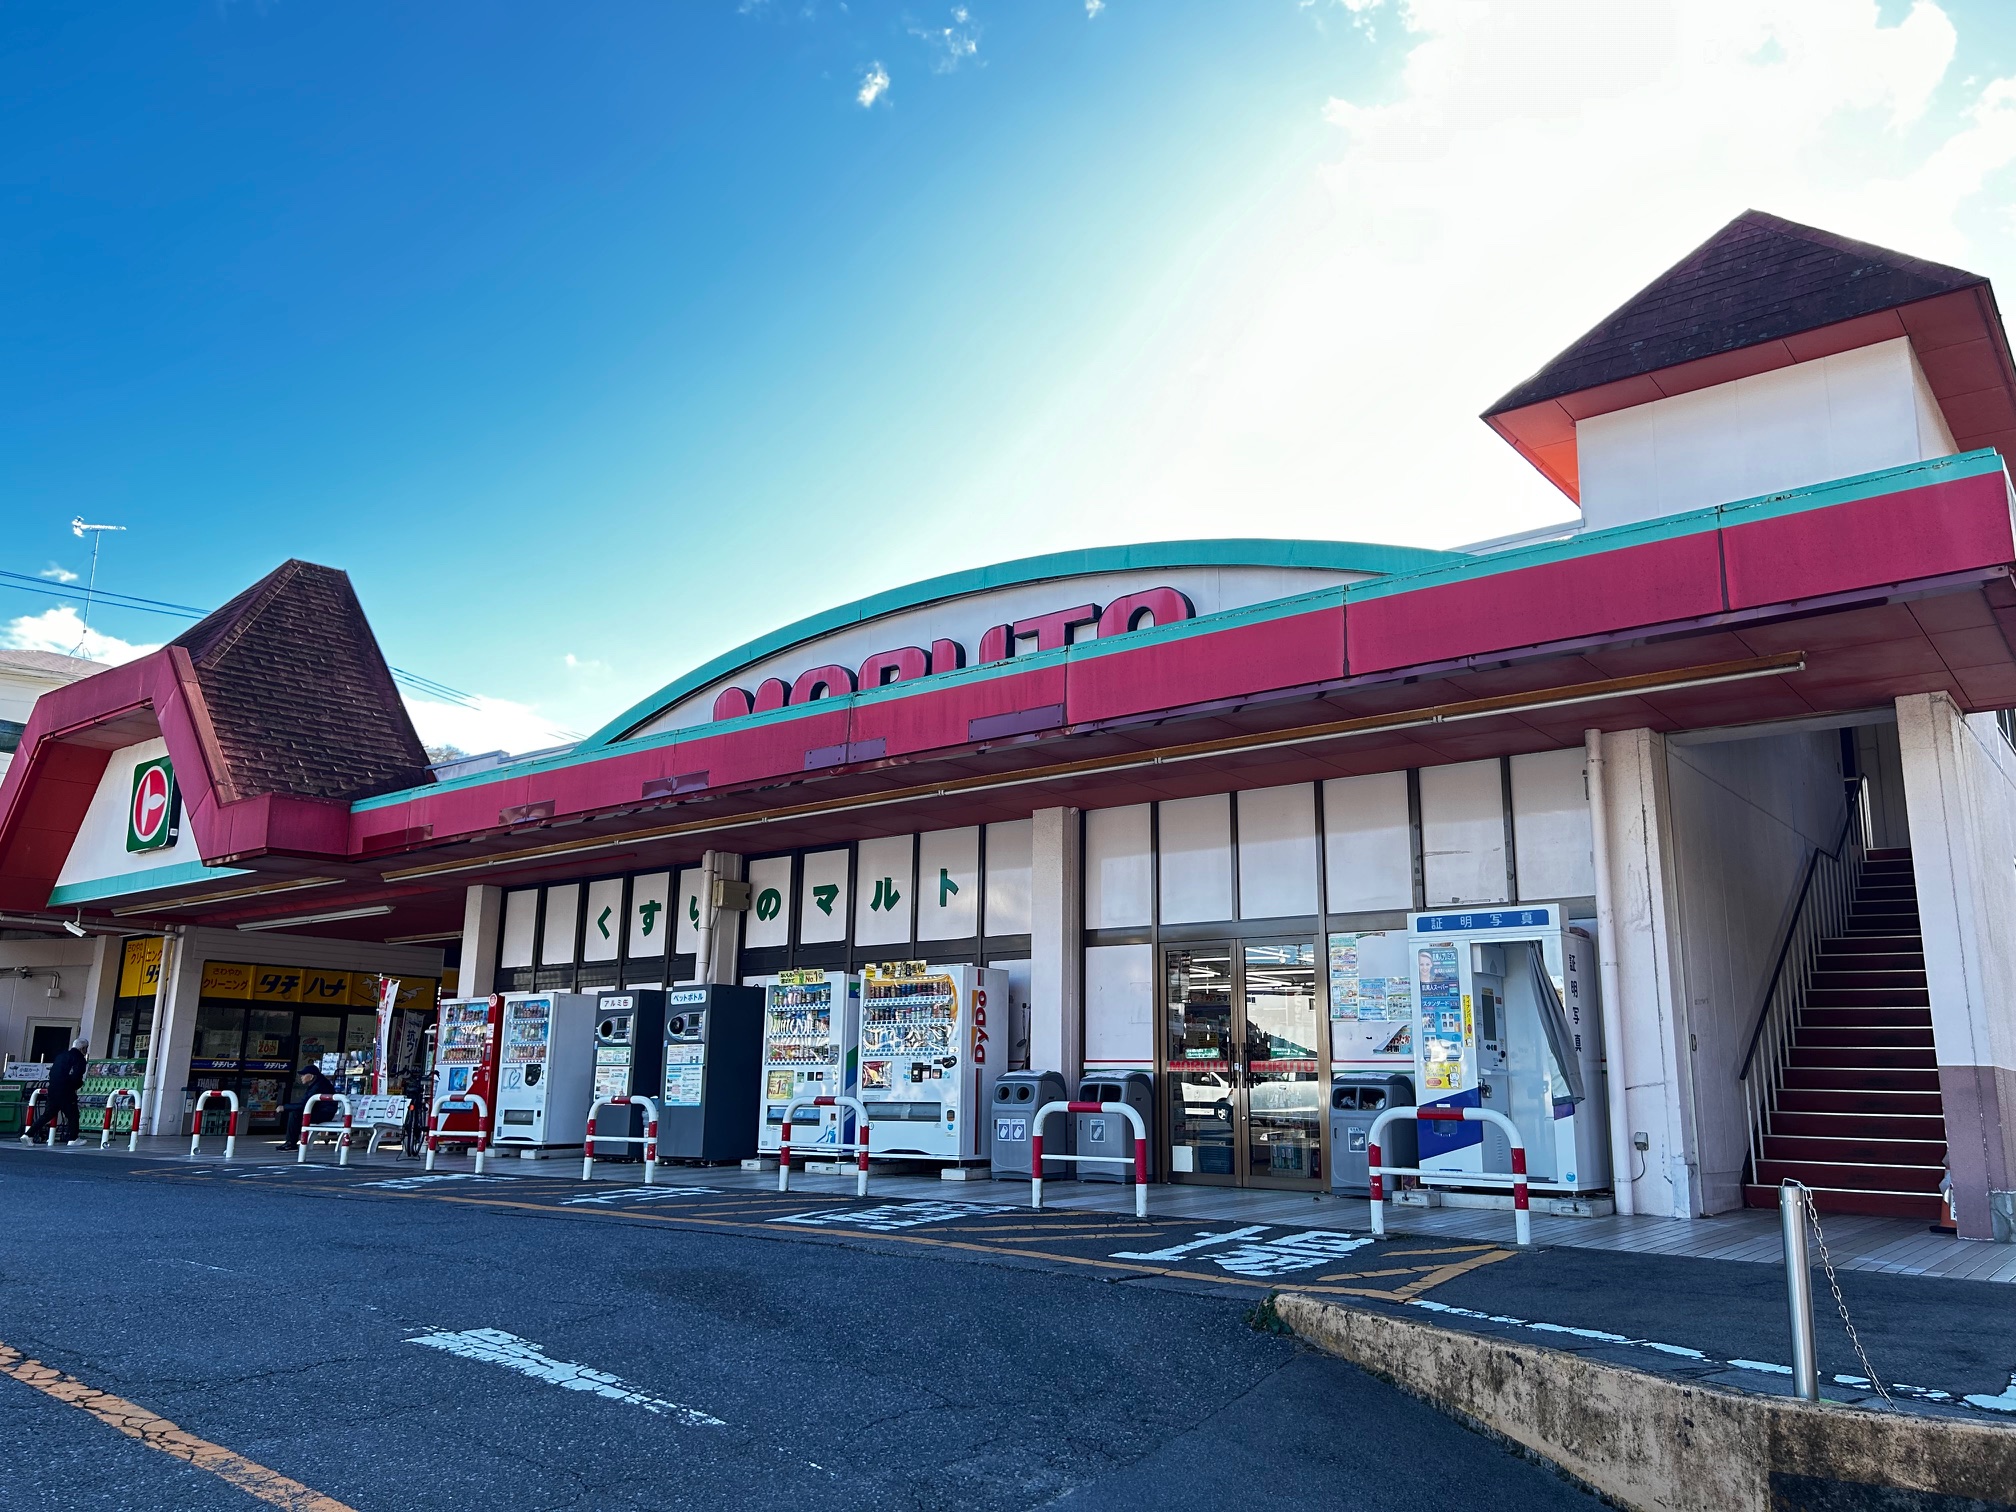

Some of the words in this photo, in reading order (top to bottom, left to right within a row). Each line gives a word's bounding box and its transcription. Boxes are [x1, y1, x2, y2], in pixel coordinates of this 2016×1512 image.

[1431, 912, 1533, 930] 証明写真
[212, 967, 243, 976] さわやか
[203, 978, 249, 991] クリーニング
[255, 974, 347, 998] タチハナ
[673, 993, 704, 1001] ペットボトル
[604, 999, 629, 1007] アルミ缶
[1568, 953, 1582, 1053] 証明写真
[211, 1060, 237, 1068] タチハナ
[263, 1061, 288, 1069] タチハナ
[1251, 1061, 1315, 1072] MARUTO
